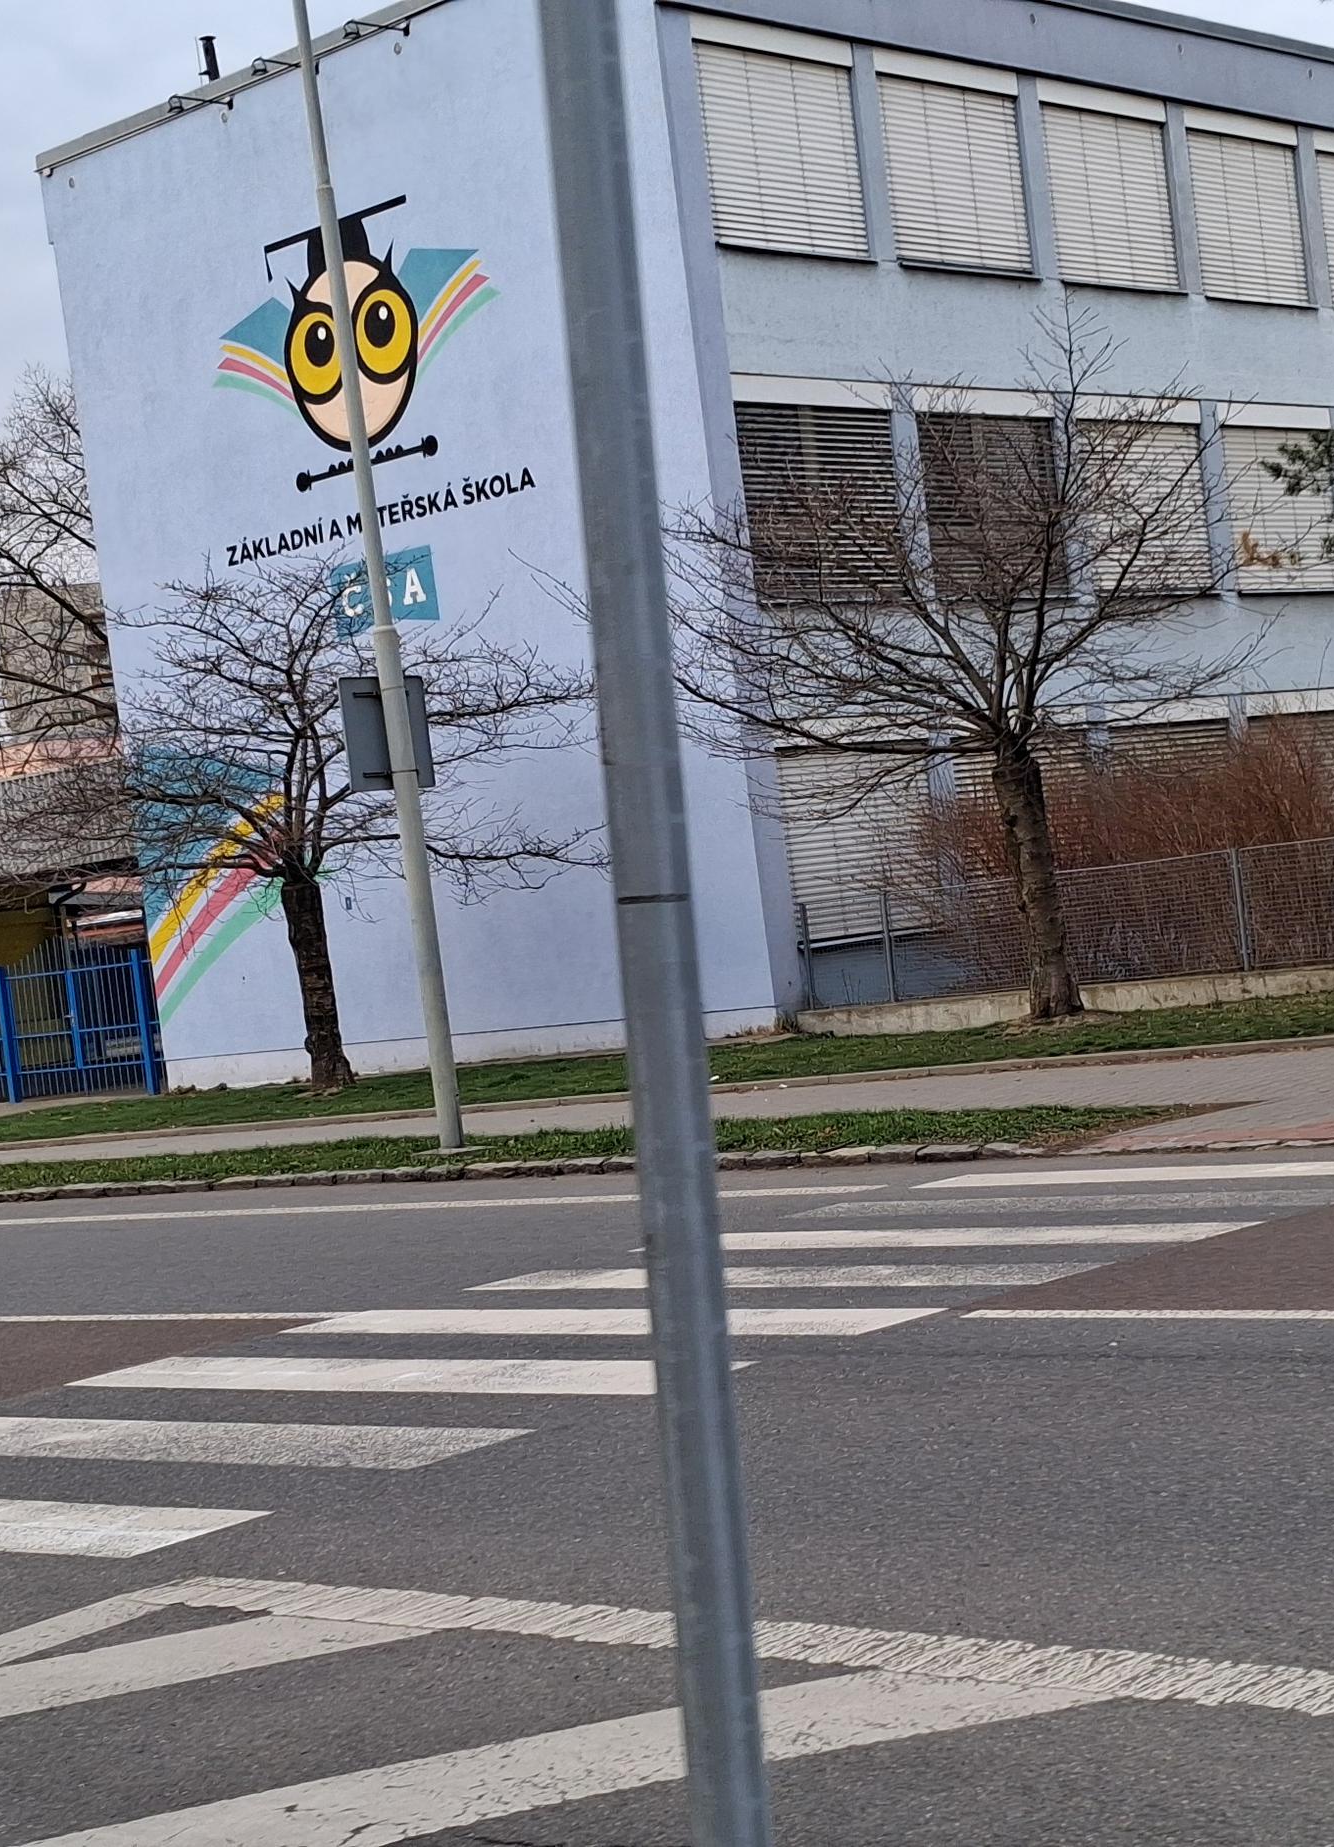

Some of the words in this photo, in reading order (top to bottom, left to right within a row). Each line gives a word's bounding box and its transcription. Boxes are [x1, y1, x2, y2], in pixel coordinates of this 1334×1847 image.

[226, 517, 324, 567] ZÁKLADNÍ
[329, 518, 344, 541] A
[347, 483, 458, 537] MTEŘSKÁ
[462, 466, 536, 506] ŠKOLA
[341, 567, 427, 617] ČA
